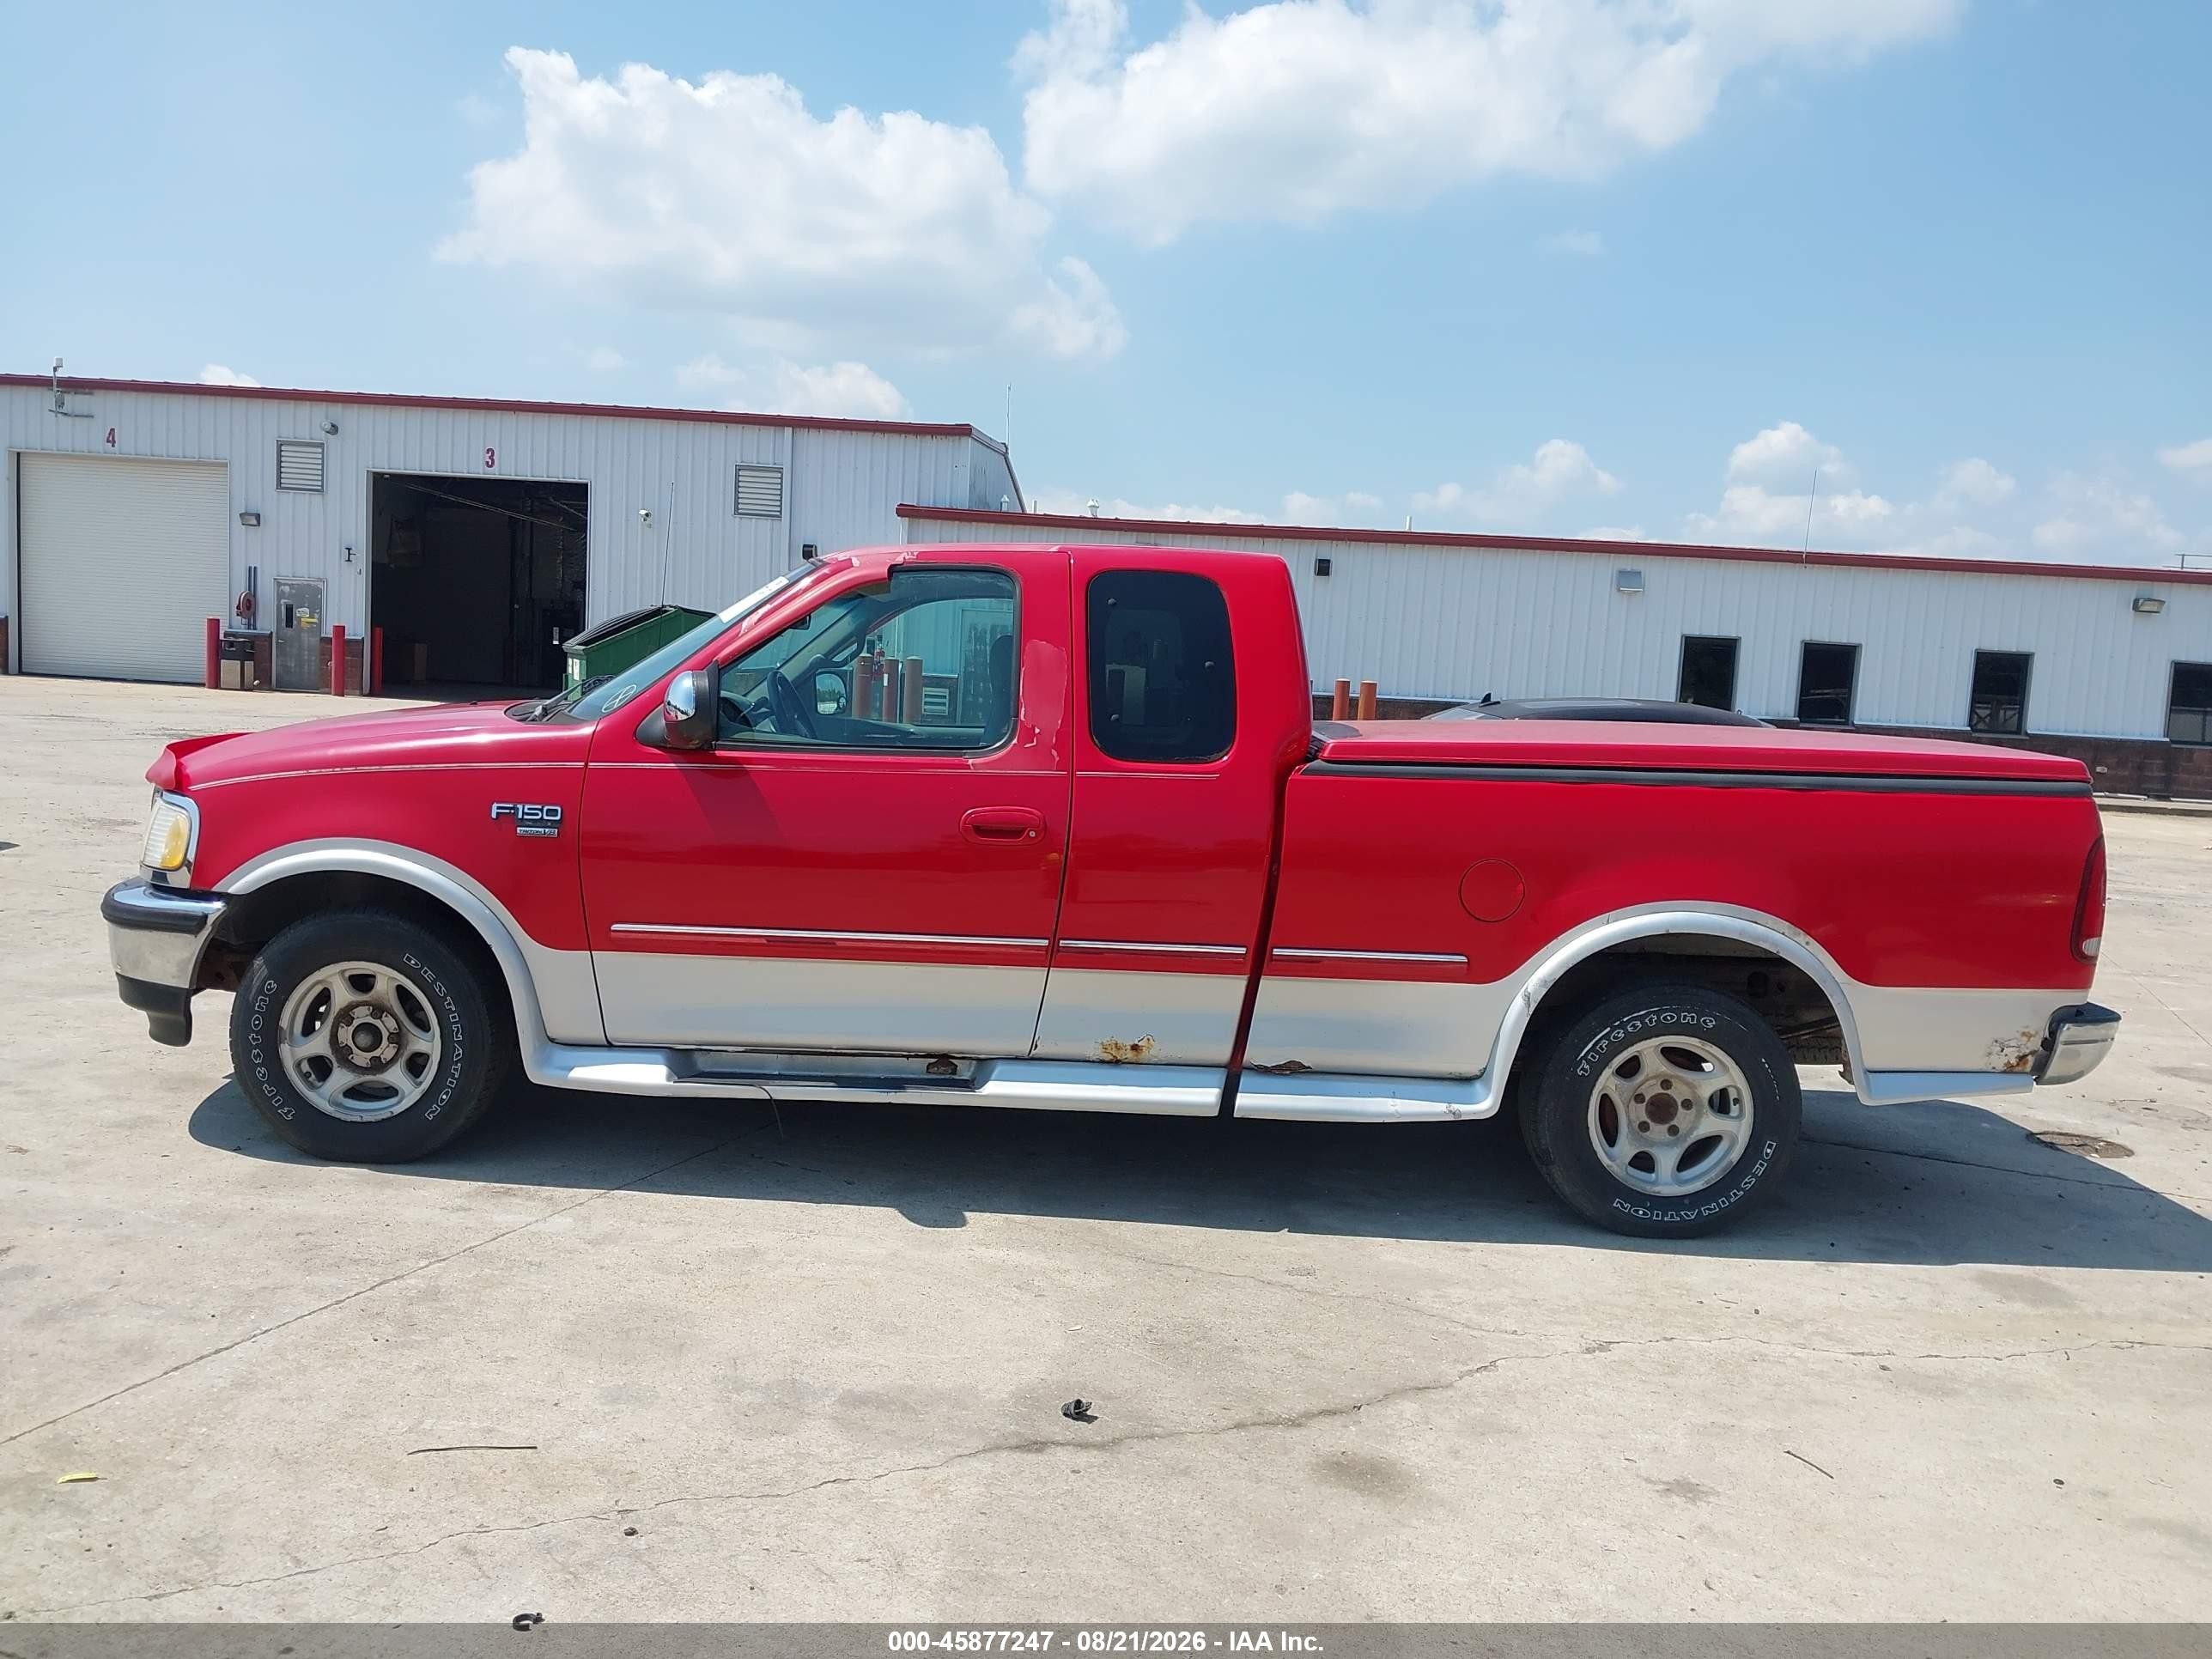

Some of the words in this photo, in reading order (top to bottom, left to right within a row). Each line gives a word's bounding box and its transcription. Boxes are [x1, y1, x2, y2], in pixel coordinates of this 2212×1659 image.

[106, 428, 117, 447] 4
[484, 447, 495, 469] 3
[404, 953, 464, 1120] DESTINATION
[1613, 1140, 1777, 1221] DESTINATION
